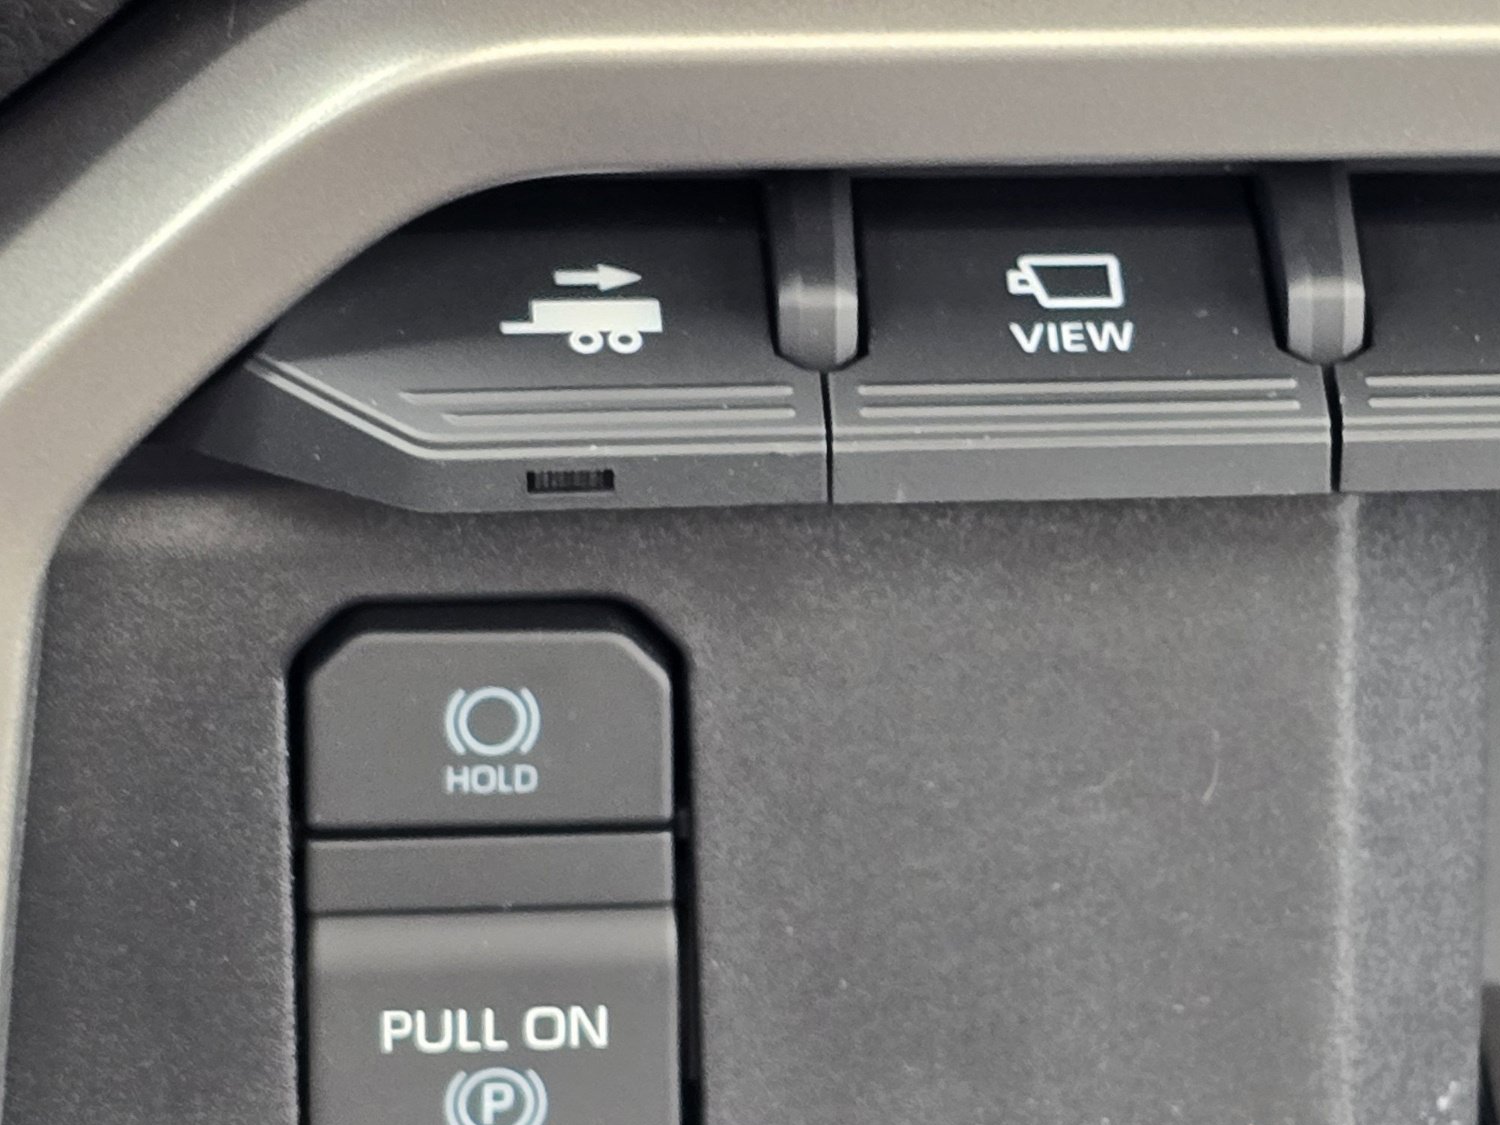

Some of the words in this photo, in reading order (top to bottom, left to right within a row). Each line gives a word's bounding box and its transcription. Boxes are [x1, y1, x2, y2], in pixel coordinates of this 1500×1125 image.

[1008, 319, 1134, 353] VIEW
[445, 763, 539, 794] HOLD
[380, 1008, 508, 1053] PULL
[523, 1004, 609, 1050] ON
[481, 1081, 515, 1125] P
